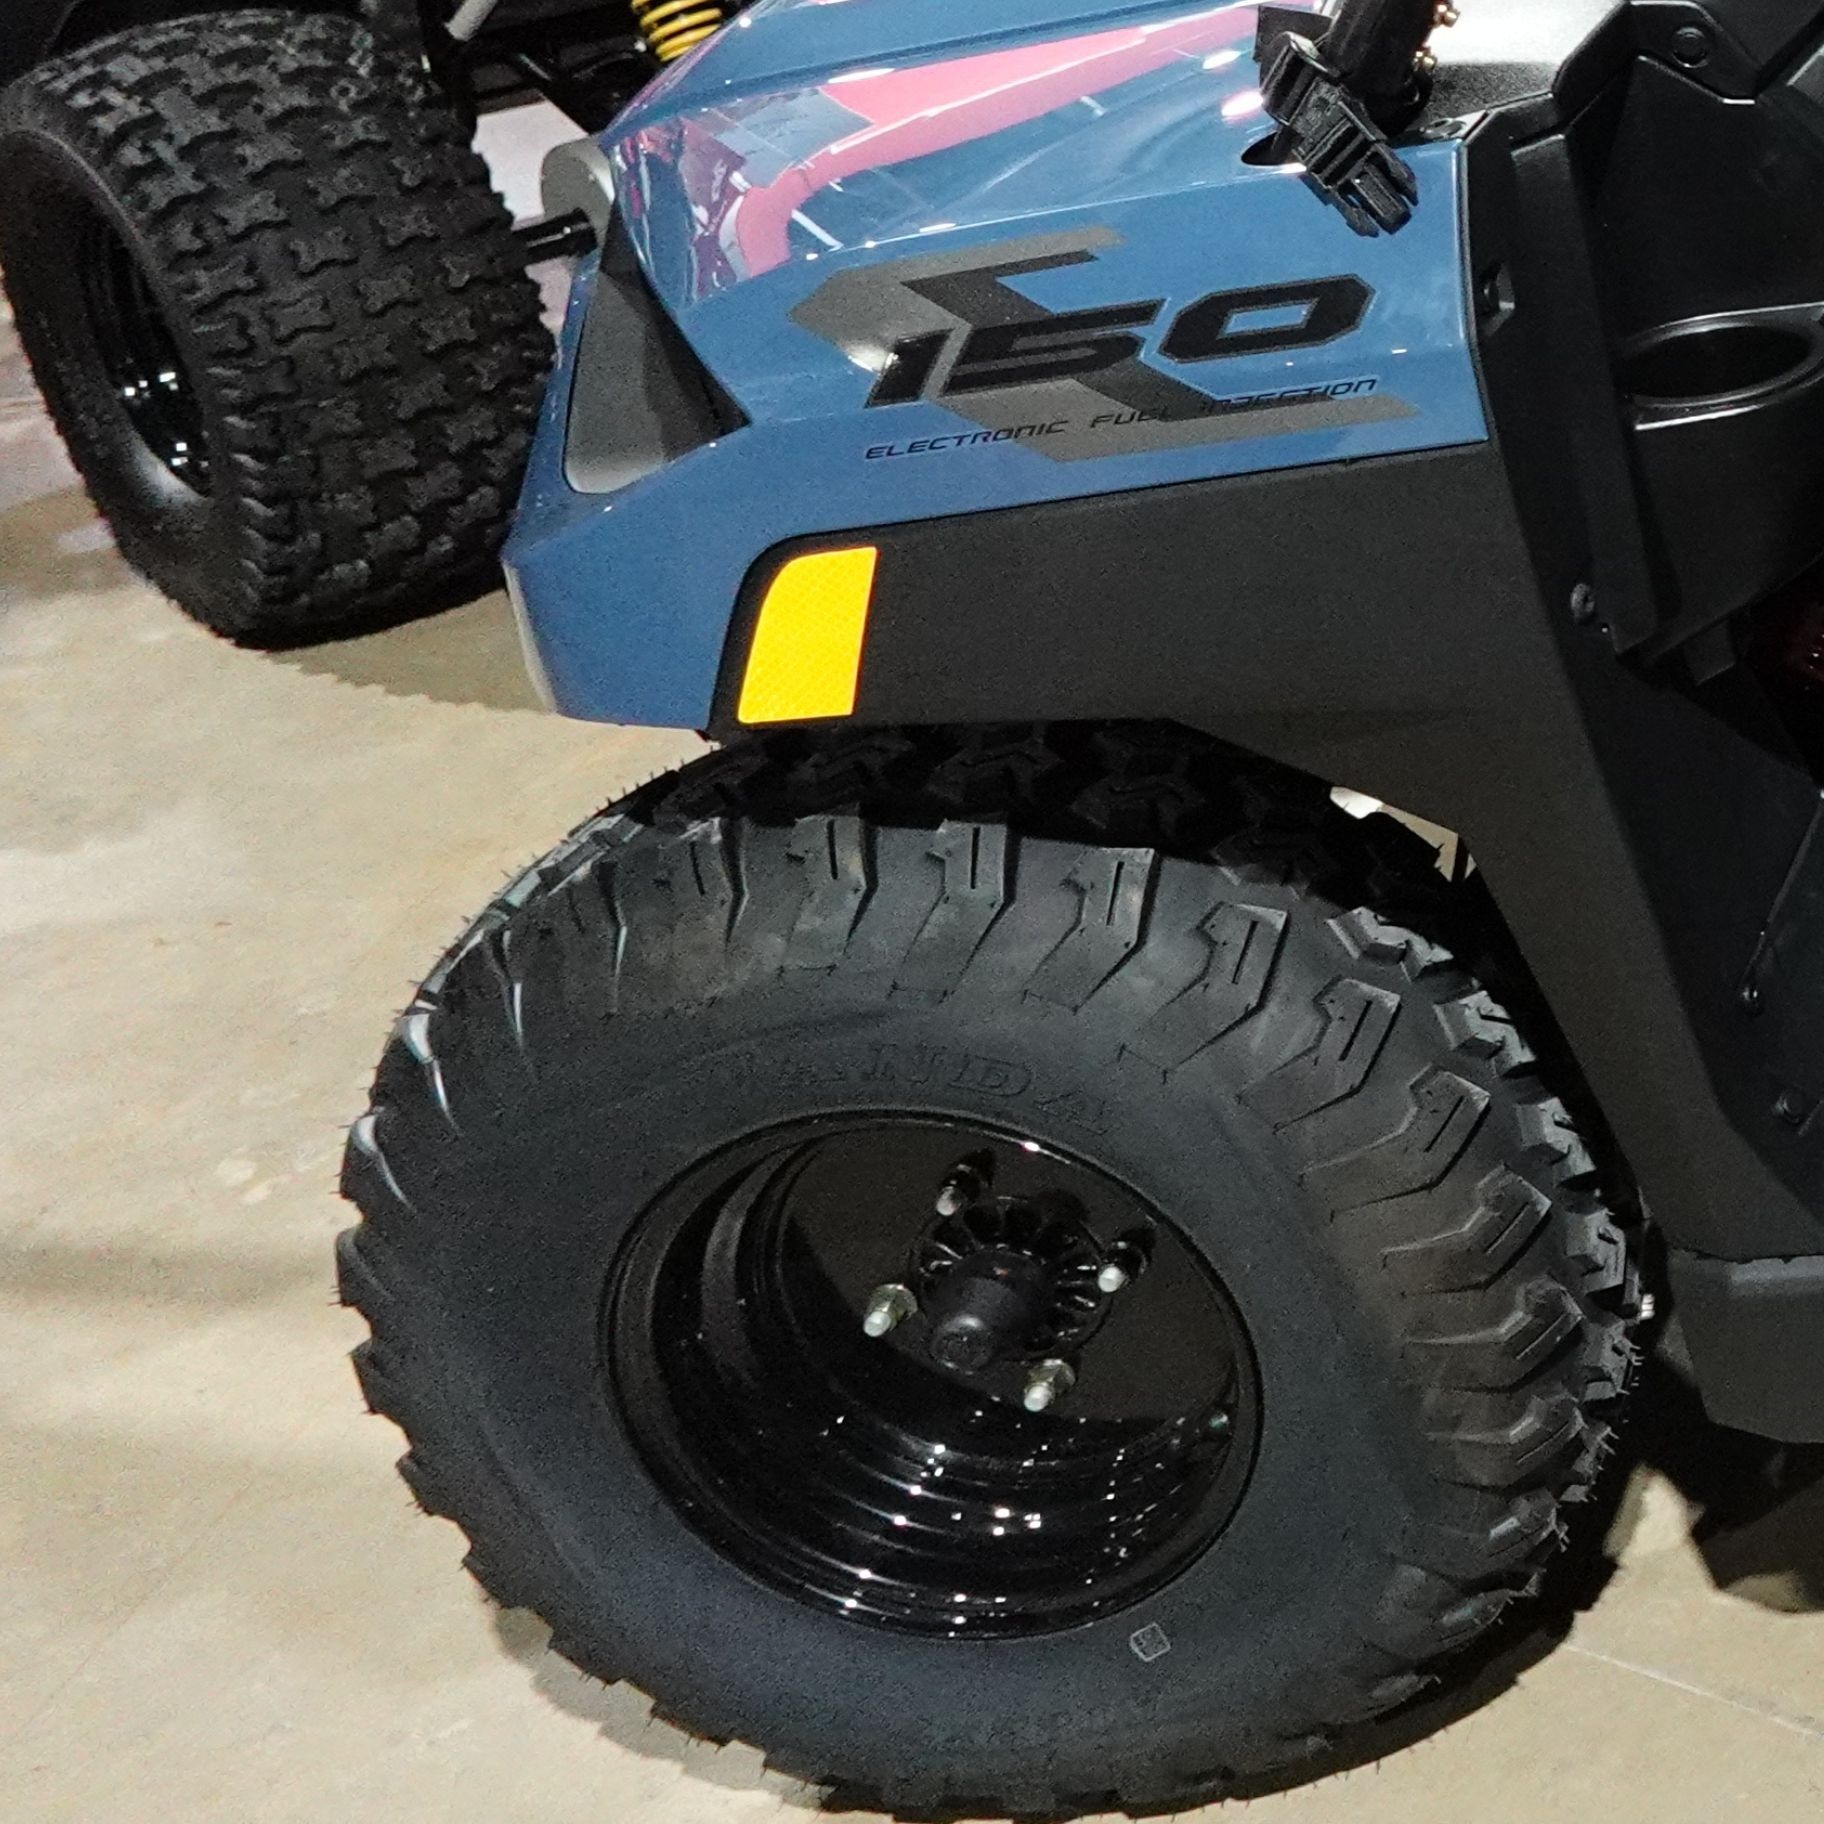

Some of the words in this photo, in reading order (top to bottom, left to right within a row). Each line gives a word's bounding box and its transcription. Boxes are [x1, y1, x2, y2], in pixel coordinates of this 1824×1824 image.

[866, 274, 1376, 409] 150
[864, 418, 1070, 461] ELECTRONIC
[1090, 404, 1172, 431] FUEL
[1195, 378, 1379, 416] INJECTION
